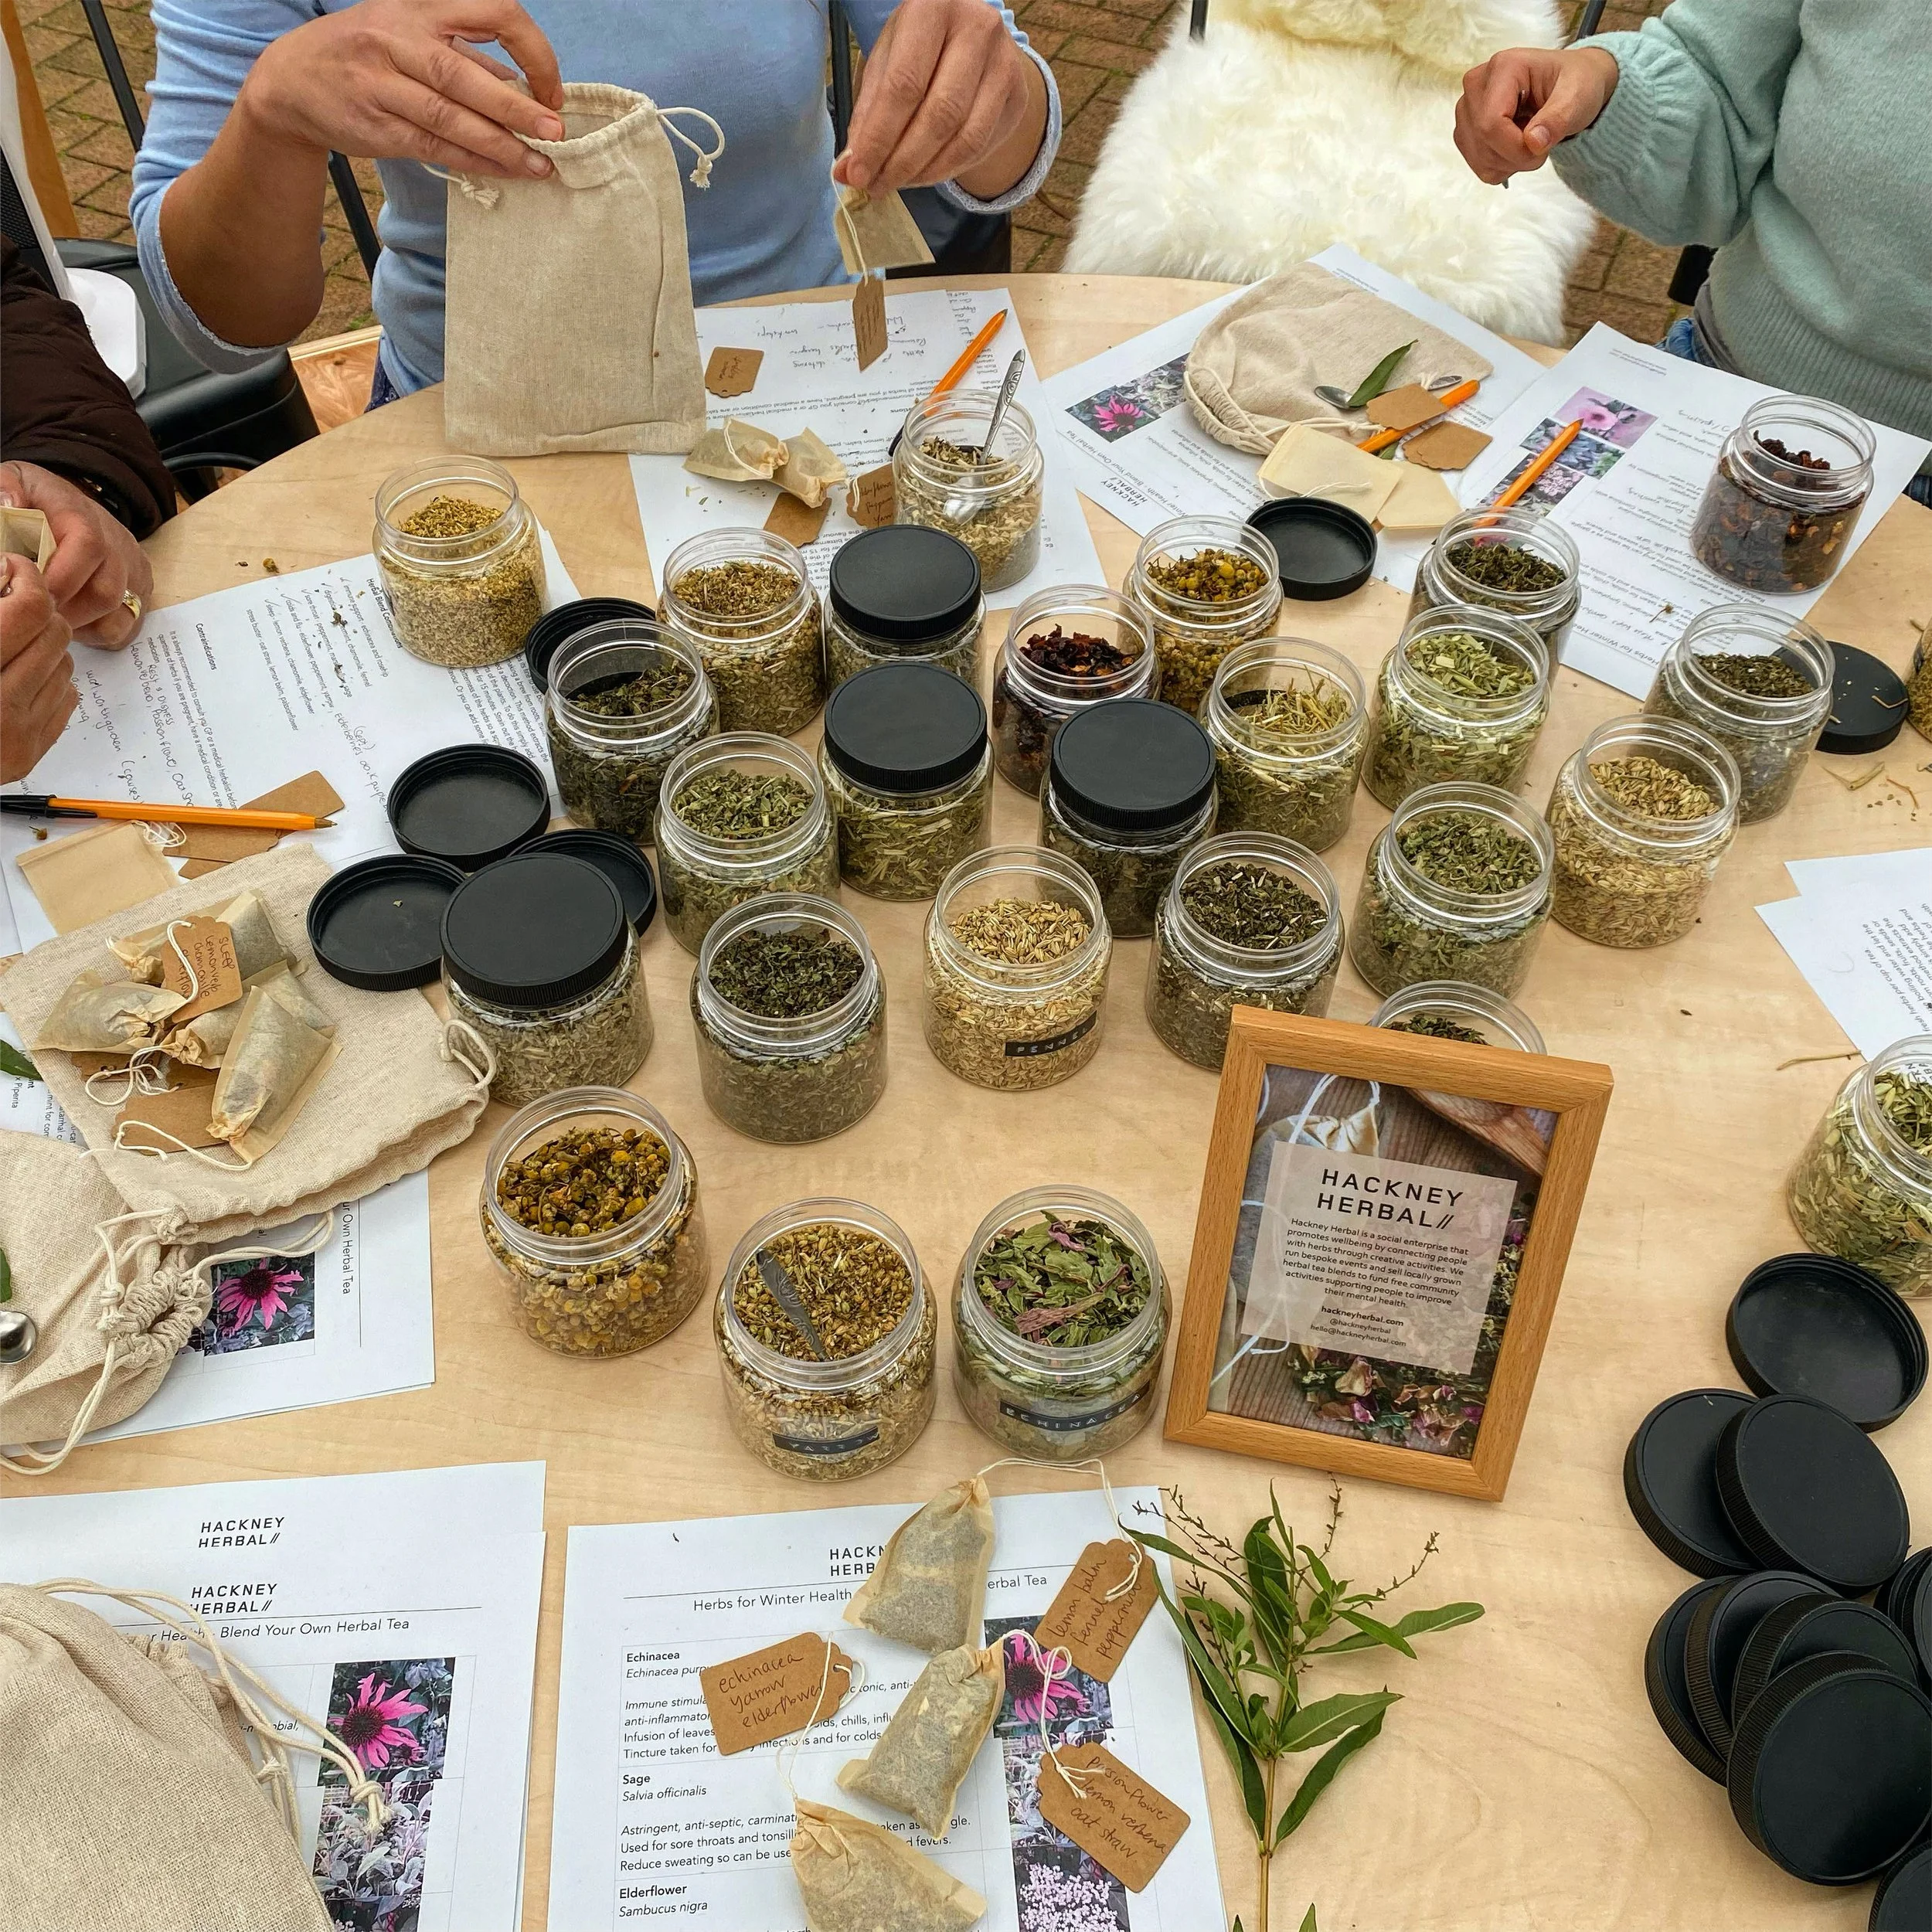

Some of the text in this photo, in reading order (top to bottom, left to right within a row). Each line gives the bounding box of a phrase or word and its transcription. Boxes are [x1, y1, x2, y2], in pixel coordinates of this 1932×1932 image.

[1066, 430, 1076, 440] Tea
[1076, 438, 1096, 454] Herbal
[1097, 452, 1111, 463] Own
[1113, 464, 1124, 474] Your
[1124, 472, 1144, 486] Blend
[1101, 480, 1140, 506] HACKNEY
[1109, 477, 1148, 502] HERBAL//
[1148, 488, 1165, 504] Health
[366, 578, 388, 611] Herbal Blend
[196, 623, 216, 670] Contraindications
[1593, 631, 1618, 647] Winter
[1619, 645, 1632, 653] for
[246, 609, 298, 730] stress buster oat straw, lemon balm, passionflower
[172, 640, 182, 656] always
[178, 656, 197, 692] recommended
[193, 698, 206, 716] consult
[203, 726, 213, 735] GP
[210, 747, 224, 768] medical
[218, 768, 231, 792] herbalist
[1864, 947, 1876, 962] tea.
[1879, 969, 1892, 981] cup
[1889, 983, 1903, 994] per
[1900, 995, 1917, 1014] herbs
[1914, 1015, 1930, 1032] fresh
[12, 1083, 22, 1108] Piperita
[1321, 1168, 1463, 1206] HACKNEY
[1317, 1192, 1454, 1230] HERBAL//
[1287, 1229, 1467, 1265] promotes wellbeing by connecting people
[1291, 1218, 1328, 1232] Hackney
[1330, 1225, 1359, 1236] Herbal
[1376, 1234, 1402, 1243] social
[1403, 1239, 1447, 1251] enterprise
[1450, 1246, 1468, 1255] that
[342, 1214, 353, 1294] Own Herbal Tea
[1308, 1241, 1332, 1252] herbs
[1334, 1247, 1368, 1260] through
[1369, 1254, 1404, 1265] creative
[1406, 1260, 1447, 1273] activities.
[1450, 1267, 1464, 1275] We
[1283, 1258, 1310, 1269] herbal
[1327, 1266, 1355, 1277] blends
[1369, 1274, 1389, 1283] fund
[1390, 1277, 1407, 1287] free
[1410, 1283, 1459, 1297] community
[1301, 1250, 1337, 1264] bespoke
[1338, 1260, 1367, 1269] events
[1403, 1269, 1432, 1281] locally
[1433, 1276, 1461, 1285] grown
[1285, 1270, 1323, 1282] activities
[1325, 1277, 1372, 1292] supporting
[1373, 1287, 1403, 1296] people
[1416, 1293, 1451, 1305] improve
[1325, 1287, 1345, 1296] their
[1346, 1292, 1376, 1302] mental
[1321, 1305, 1403, 1326] hackneyherbal.com
[1329, 1318, 1391, 1334] @hackneyherbal
[1310, 1323, 1406, 1346] hello@hackneyherbal.com
[201, 1516, 284, 1532] HACKNEY
[199, 1532, 280, 1548] HERBAL//
[831, 1563, 875, 1576] HERB
[191, 1583, 277, 1598] HACKNEY
[694, 1574, 1046, 1611] Herbs for Winter Health erbal Tea
[1046, 1560, 1107, 1637] lemon balm
[220, 1617, 409, 1638] Blend Your Own Herbal Tea
[627, 1651, 679, 1662] Echinacea
[626, 1668, 678, 1678] Echinacea
[719, 1653, 804, 1693] echinacea
[625, 1695, 706, 1709] Immune stimula
[730, 1675, 786, 1713] yarrow
[624, 1714, 869, 1742] Infusion of leaves chills,
[623, 1729, 883, 1758] Tincture taken for and for colds
[622, 1774, 650, 1786] Sage
[622, 1784, 706, 1801] Salvia officinalis
[621, 1822, 680, 1836] Astringent,
[684, 1817, 743, 1831] anti-septic,
[747, 1813, 797, 1825] carminati
[1071, 1808, 1138, 1858] oat straw
[621, 1840, 648, 1853] Used
[651, 1839, 667, 1851] for
[670, 1840, 693, 1849] sore
[697, 1835, 734, 1847] throats
[738, 1832, 758, 1843] and
[621, 1859, 661, 1871] Reduce
[665, 1855, 713, 1867] sweating
[733, 1852, 752, 1861] can
[756, 1849, 770, 1859] be
[774, 1849, 791, 1858] use
[620, 1885, 687, 1899] Elderflower
[619, 1902, 707, 1917] Sambucus nigra
